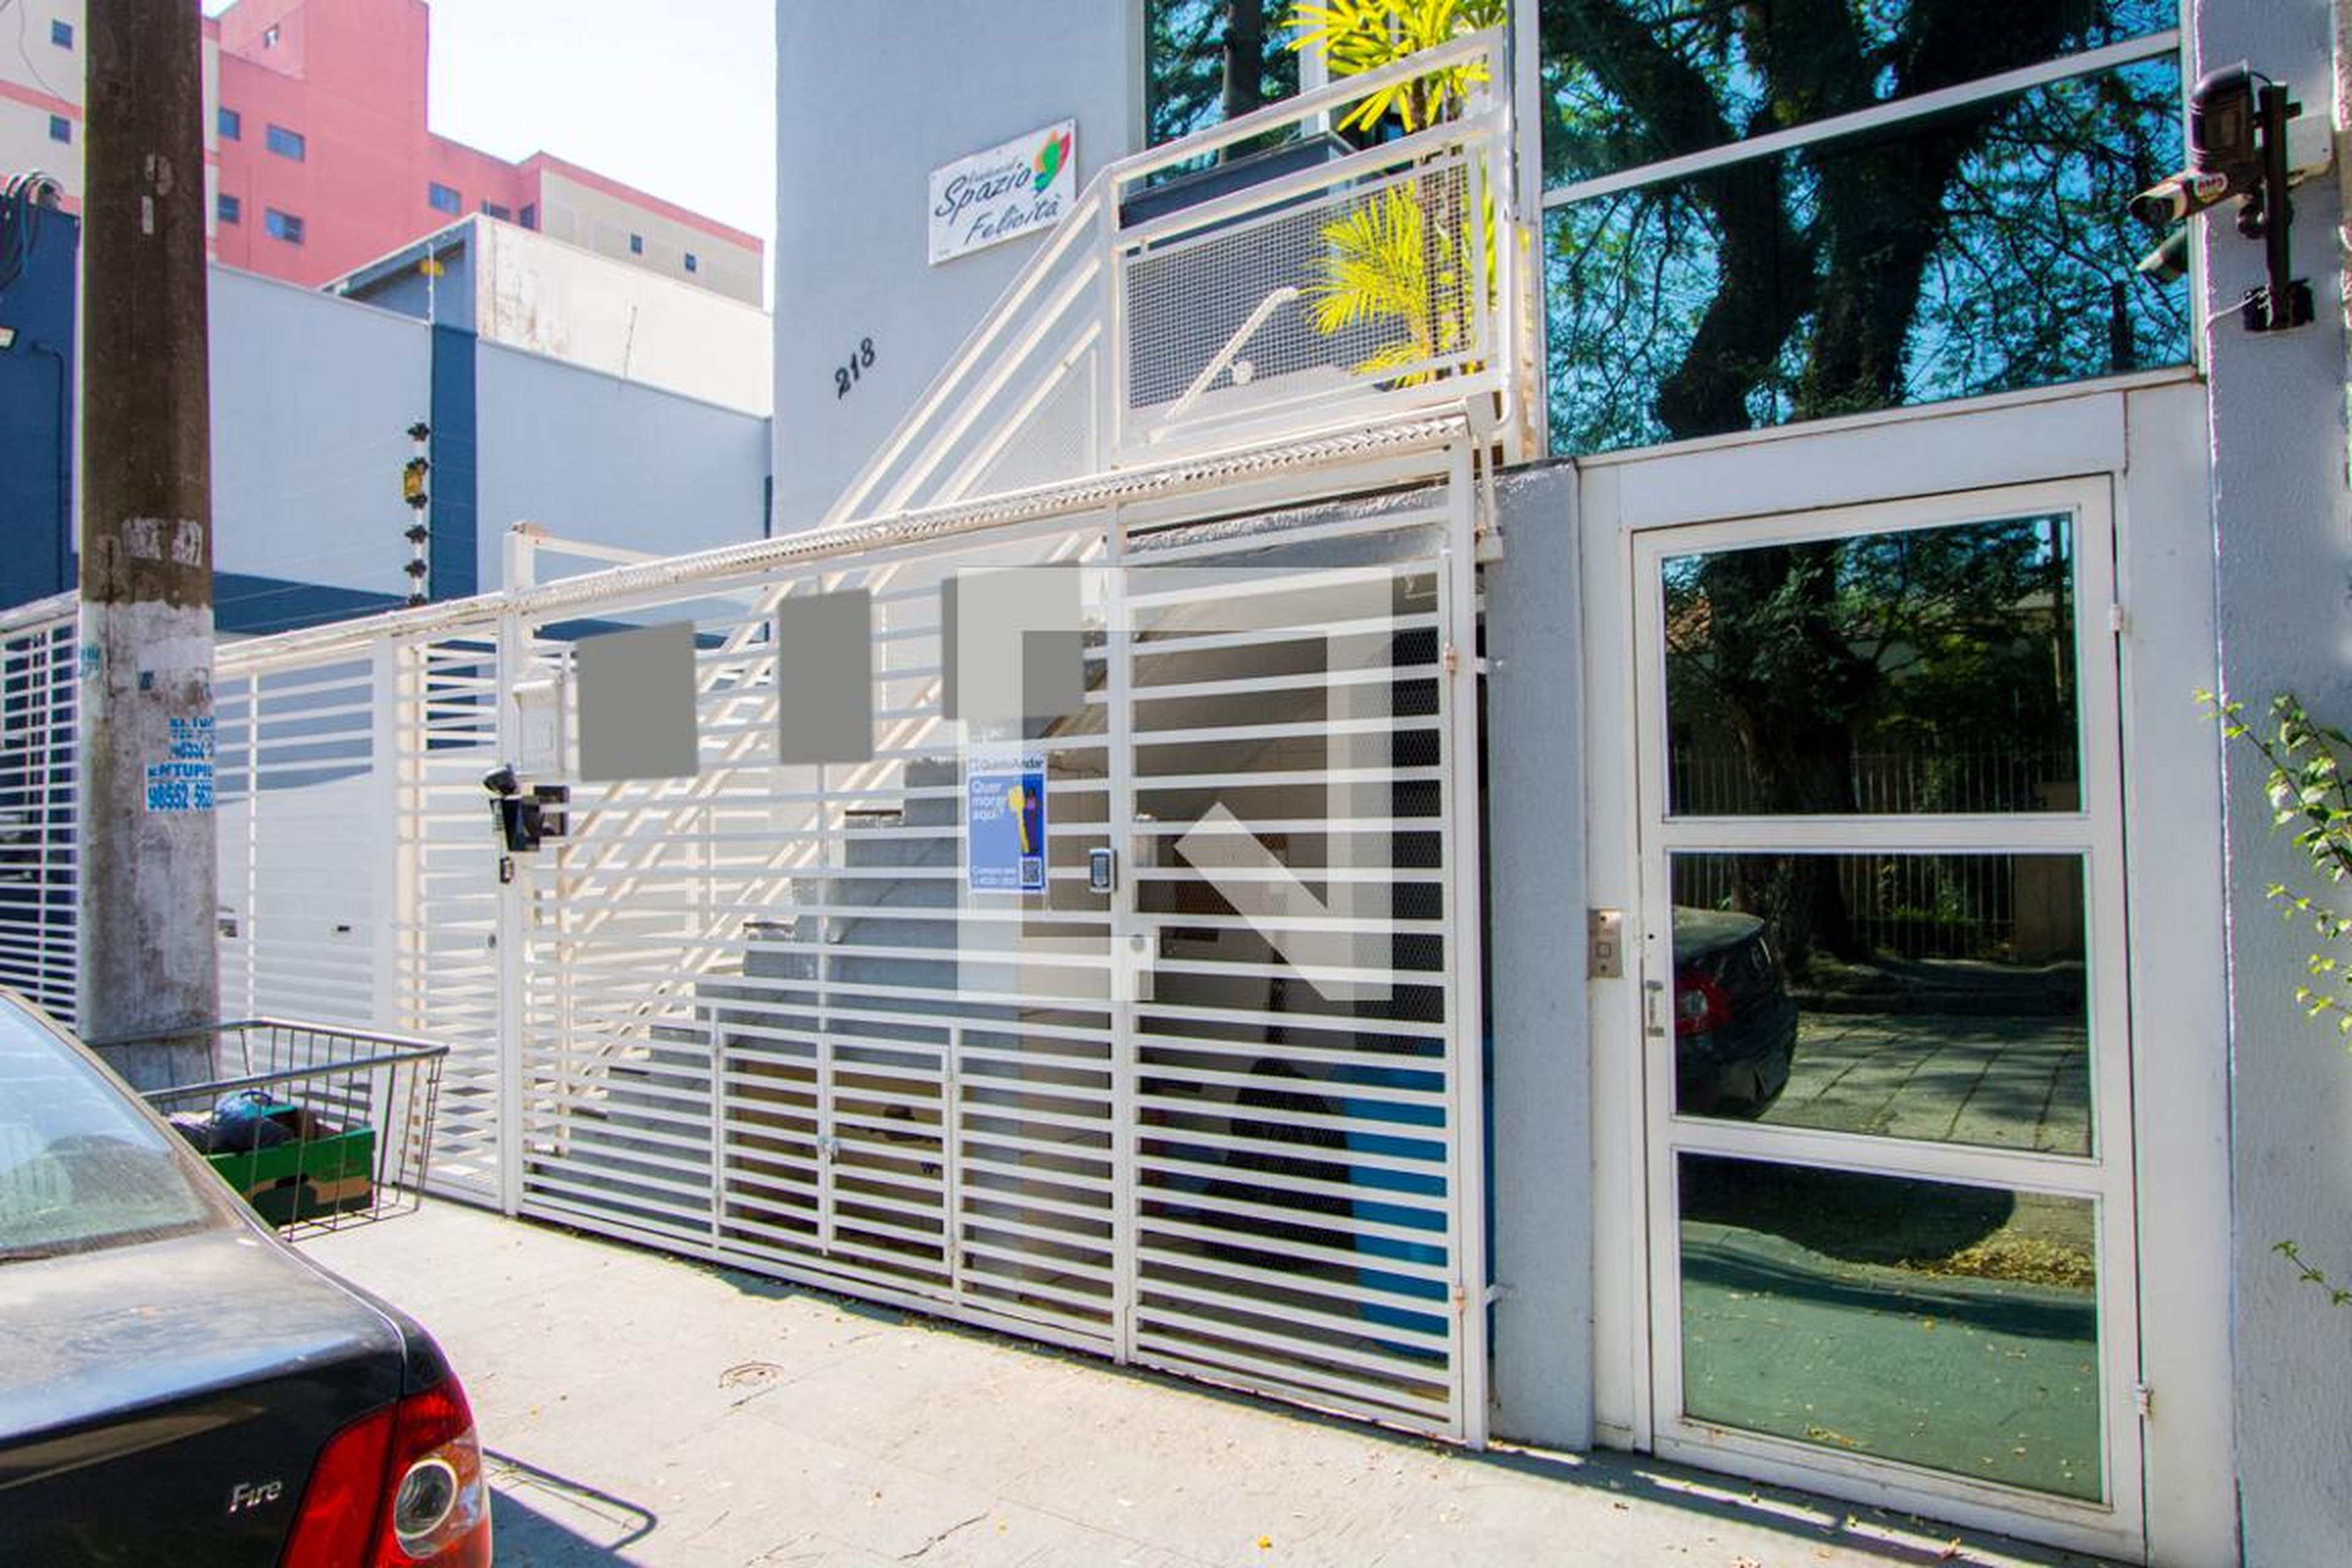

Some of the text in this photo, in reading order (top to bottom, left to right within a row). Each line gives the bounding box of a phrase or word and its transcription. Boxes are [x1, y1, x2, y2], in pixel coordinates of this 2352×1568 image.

[935, 162, 1031, 225] Spazio
[835, 336, 875, 400] 218
[228, 1479, 282, 1513] Fire
